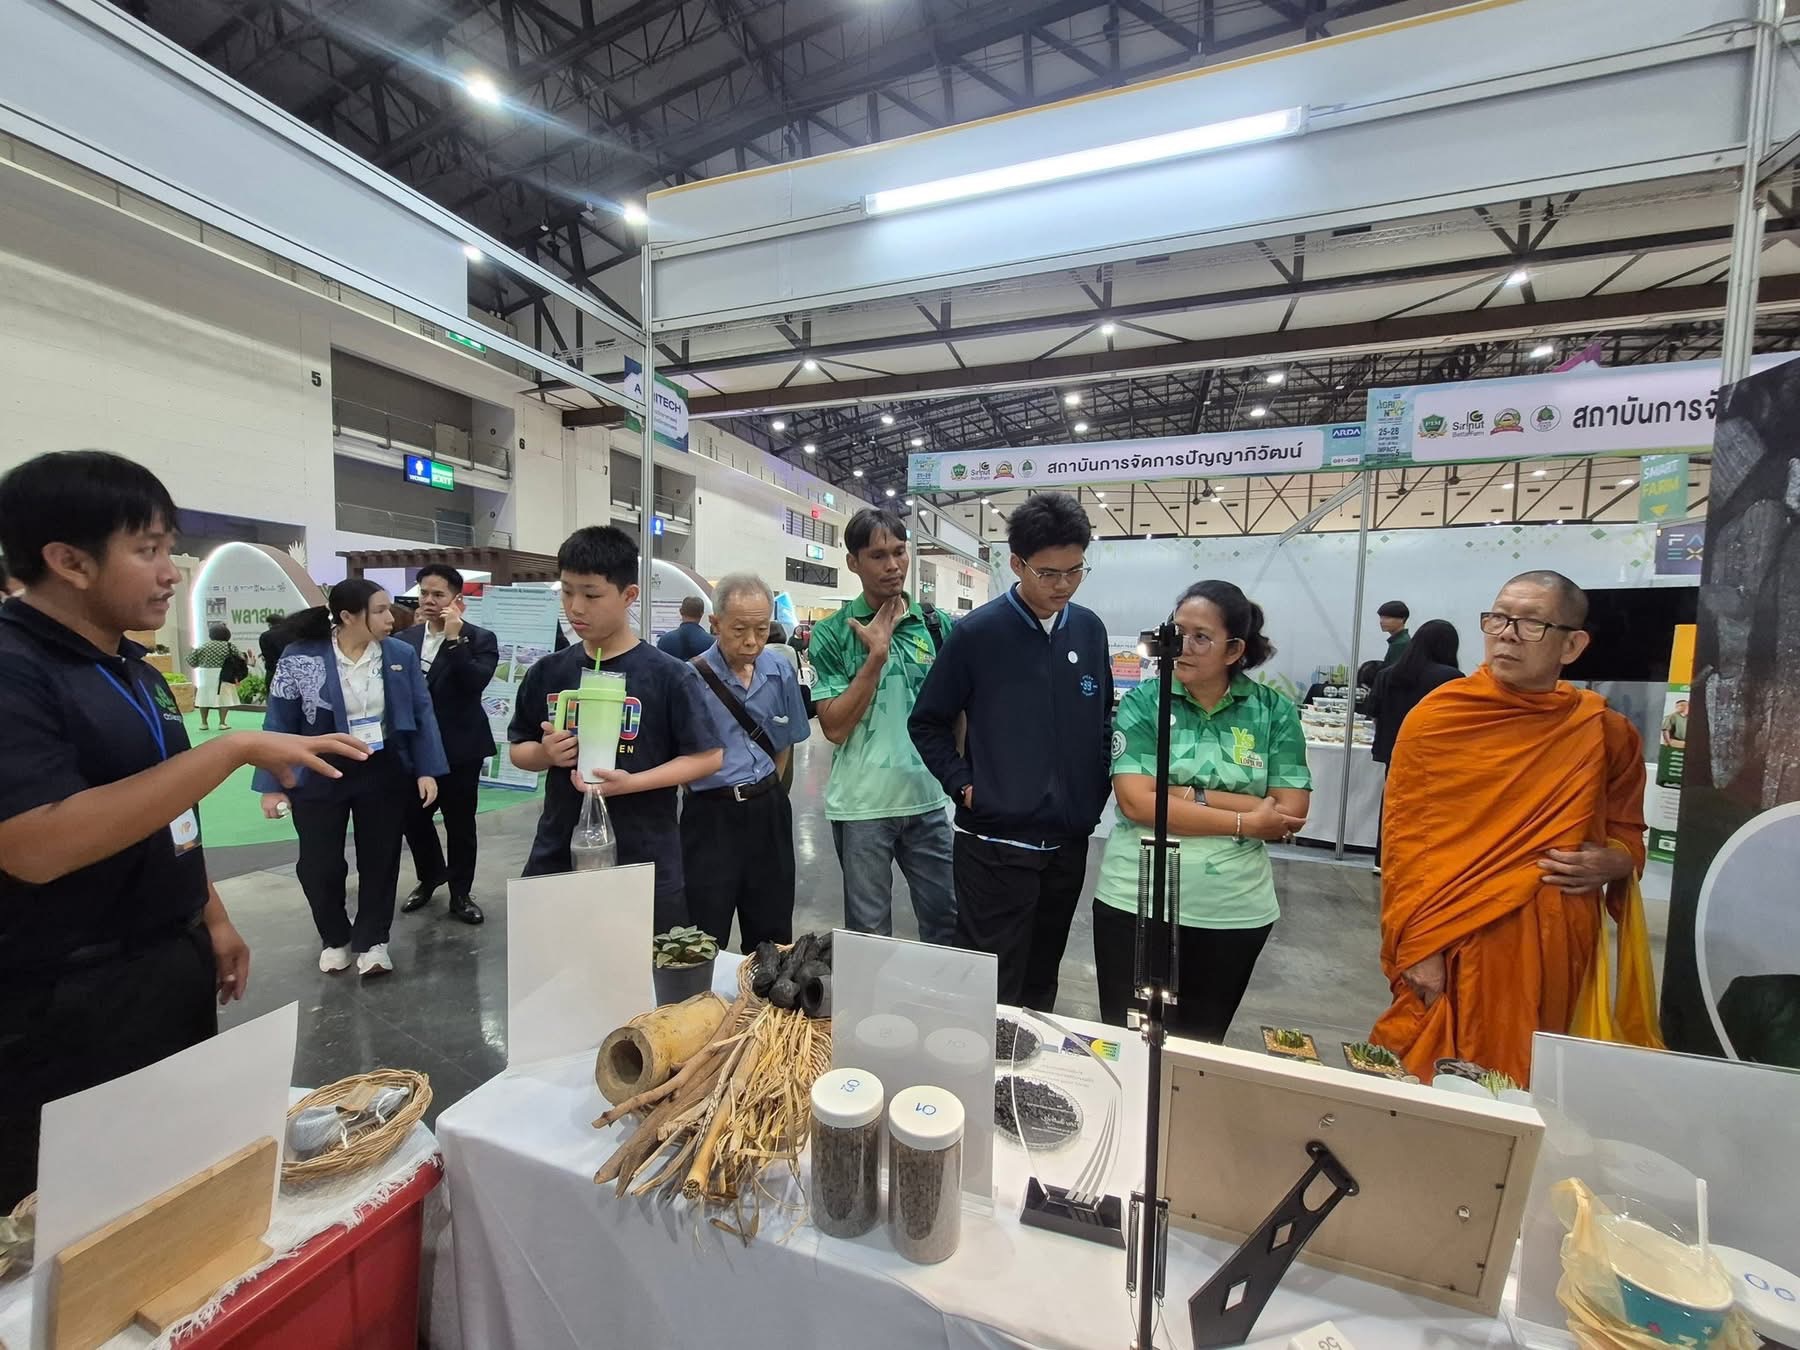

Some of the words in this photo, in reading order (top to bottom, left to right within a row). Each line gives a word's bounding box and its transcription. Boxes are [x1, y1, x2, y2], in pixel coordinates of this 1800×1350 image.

[311, 371, 322, 387] 5
[634, 383, 682, 415] AITECH
[1332, 428, 1361, 438] ARDA
[518, 438, 526, 450] 6
[1047, 441, 1304, 475] สถาบันการจัดการปัญญาภิวัฒน์
